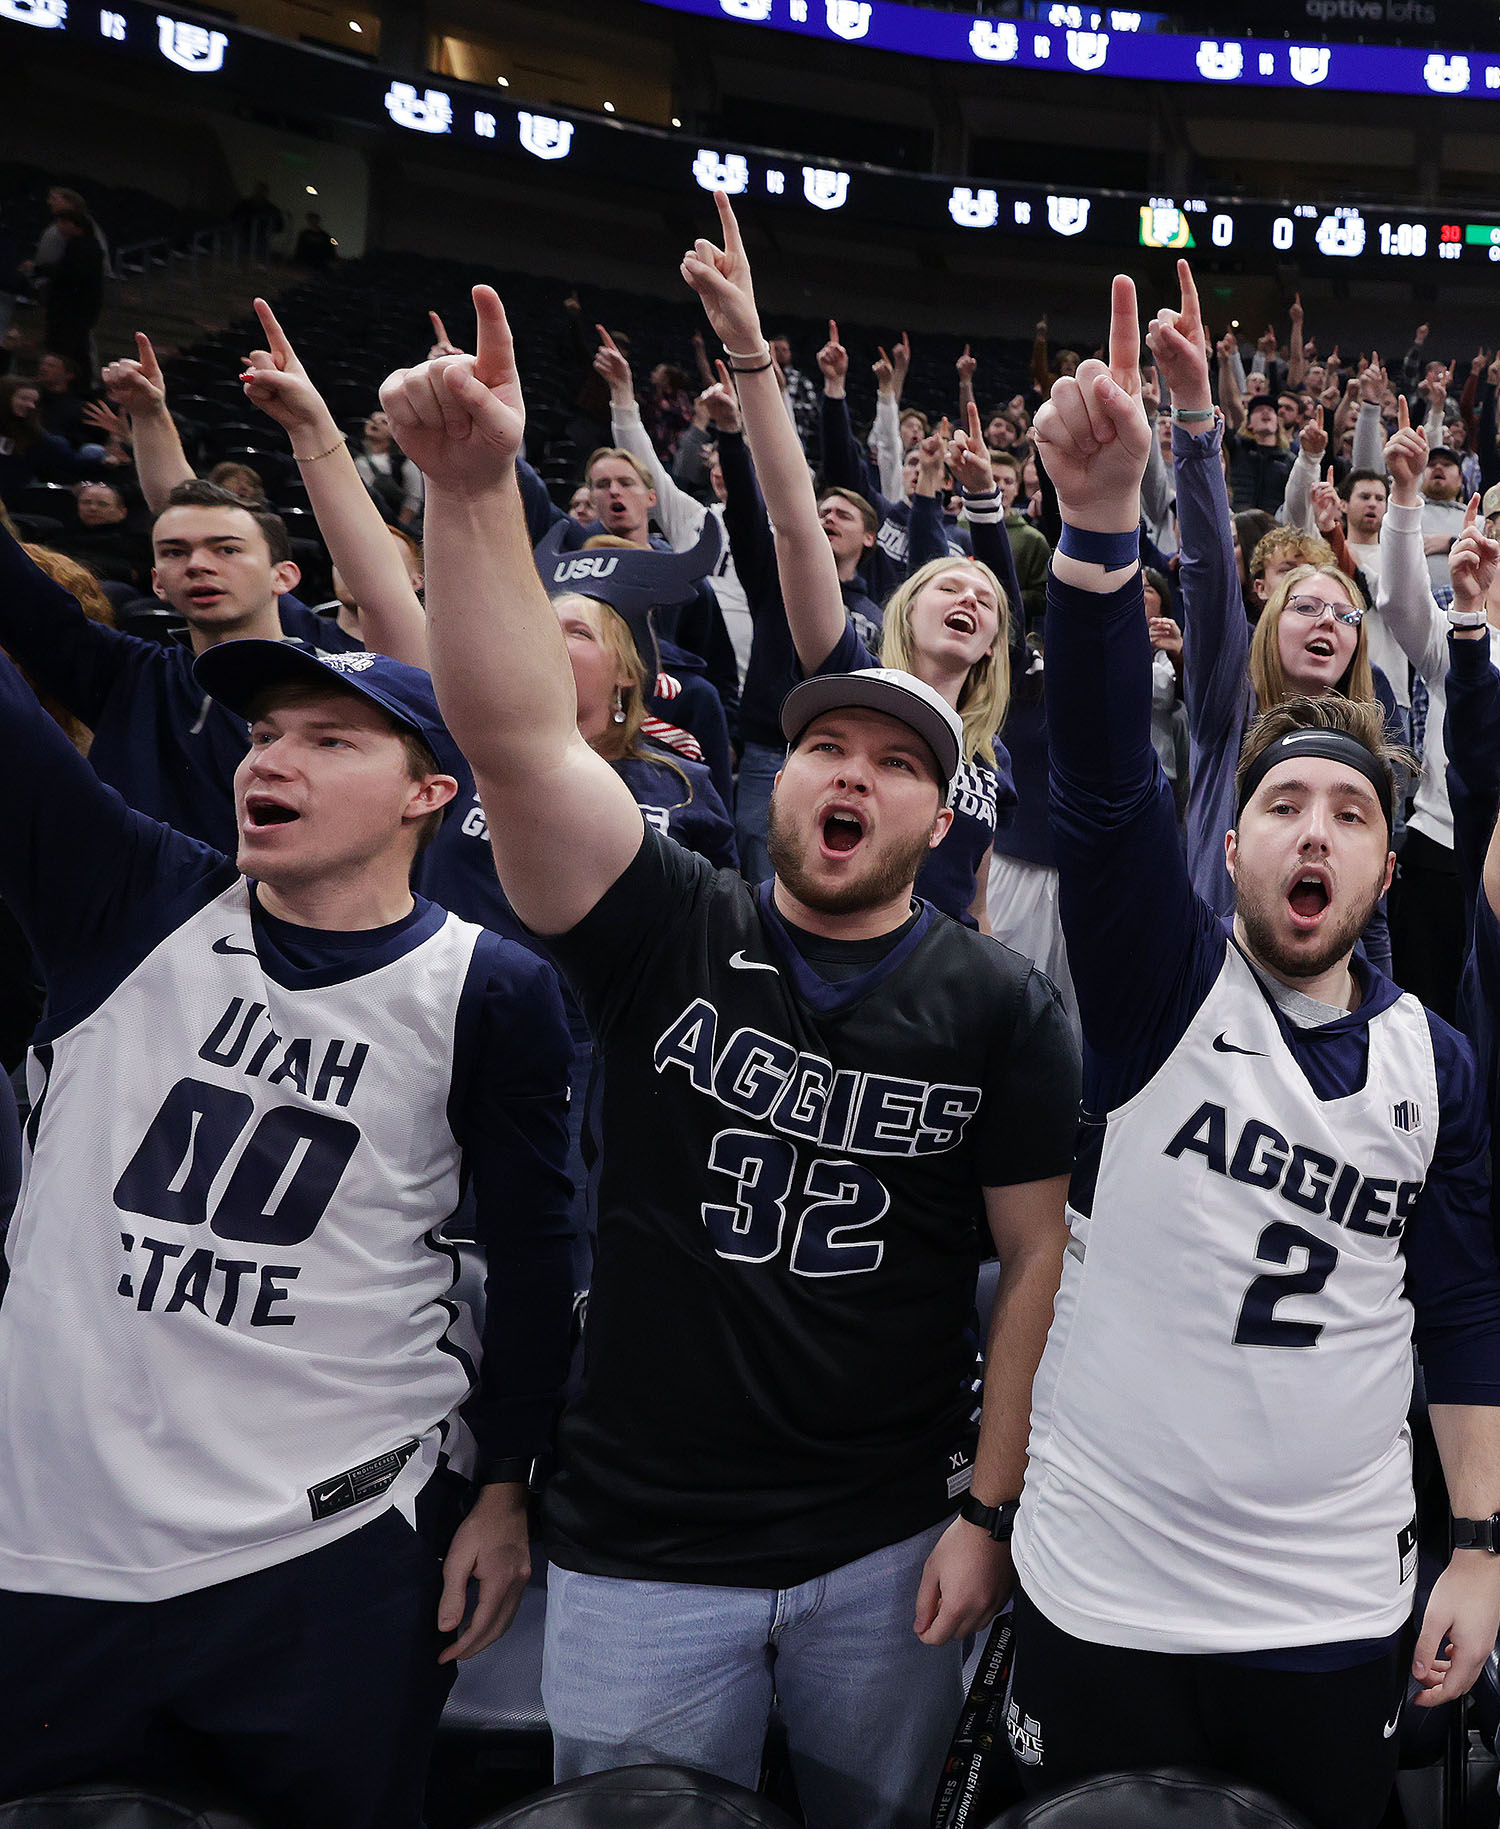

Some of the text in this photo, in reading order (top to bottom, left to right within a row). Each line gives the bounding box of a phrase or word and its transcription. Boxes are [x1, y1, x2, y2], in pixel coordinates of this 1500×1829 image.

[1212, 214, 1233, 247] 0
[1272, 217, 1294, 250] 0
[1438, 242, 1463, 260] 1ST
[553, 557, 620, 583] USU
[199, 997, 370, 1107] UTAH
[654, 997, 982, 1157] AGGIES
[112, 1077, 361, 1247] 00
[1163, 1100, 1424, 1239] AGGIES
[701, 1128, 891, 1278] 32
[1230, 1219, 1340, 1350] 2
[949, 1451, 969, 1469] XL
[1407, 1530, 1414, 1546] L
[984, 1648, 1003, 1686] GOLDEN
[967, 1753, 983, 1792] GOLDEN
